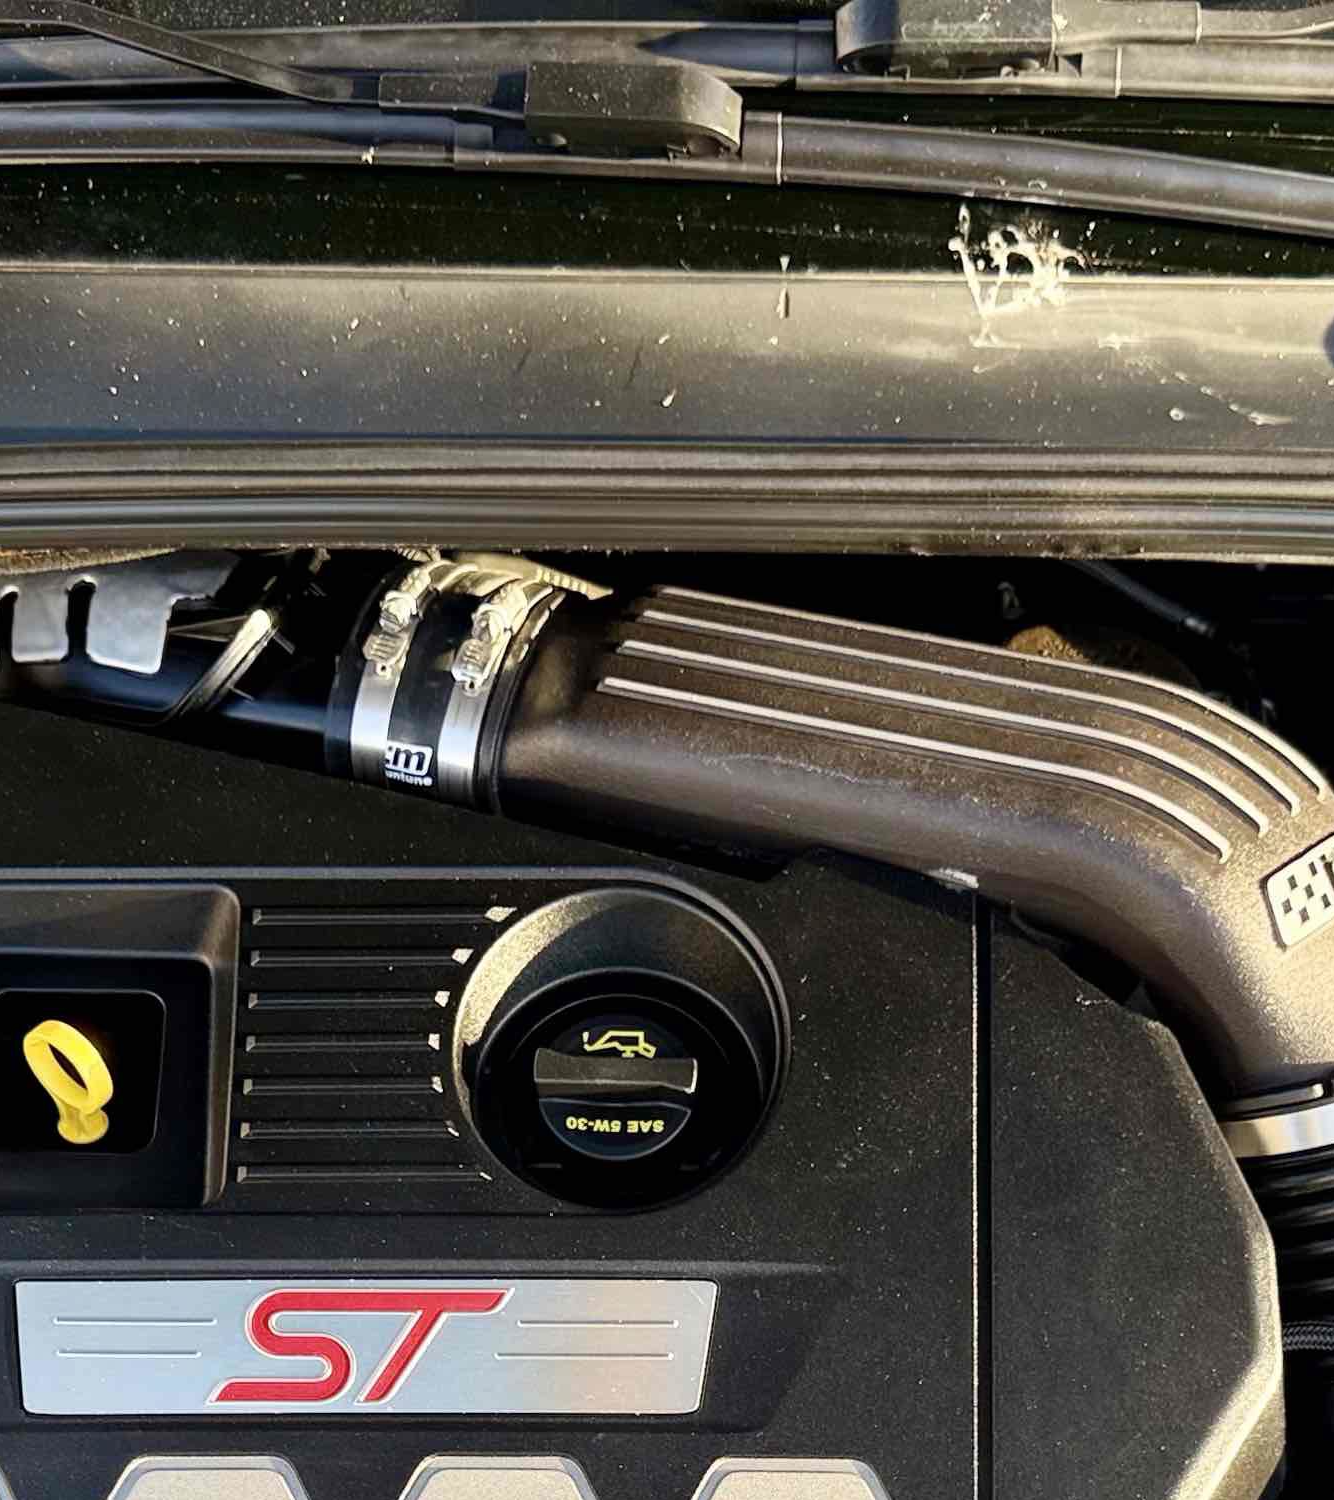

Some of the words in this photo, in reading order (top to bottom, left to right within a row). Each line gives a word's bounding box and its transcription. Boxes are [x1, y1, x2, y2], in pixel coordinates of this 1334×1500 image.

[566, 1116, 621, 1133] 5W-30
[626, 1119, 665, 1133] SAE
[206, 1287, 515, 1406] ST
